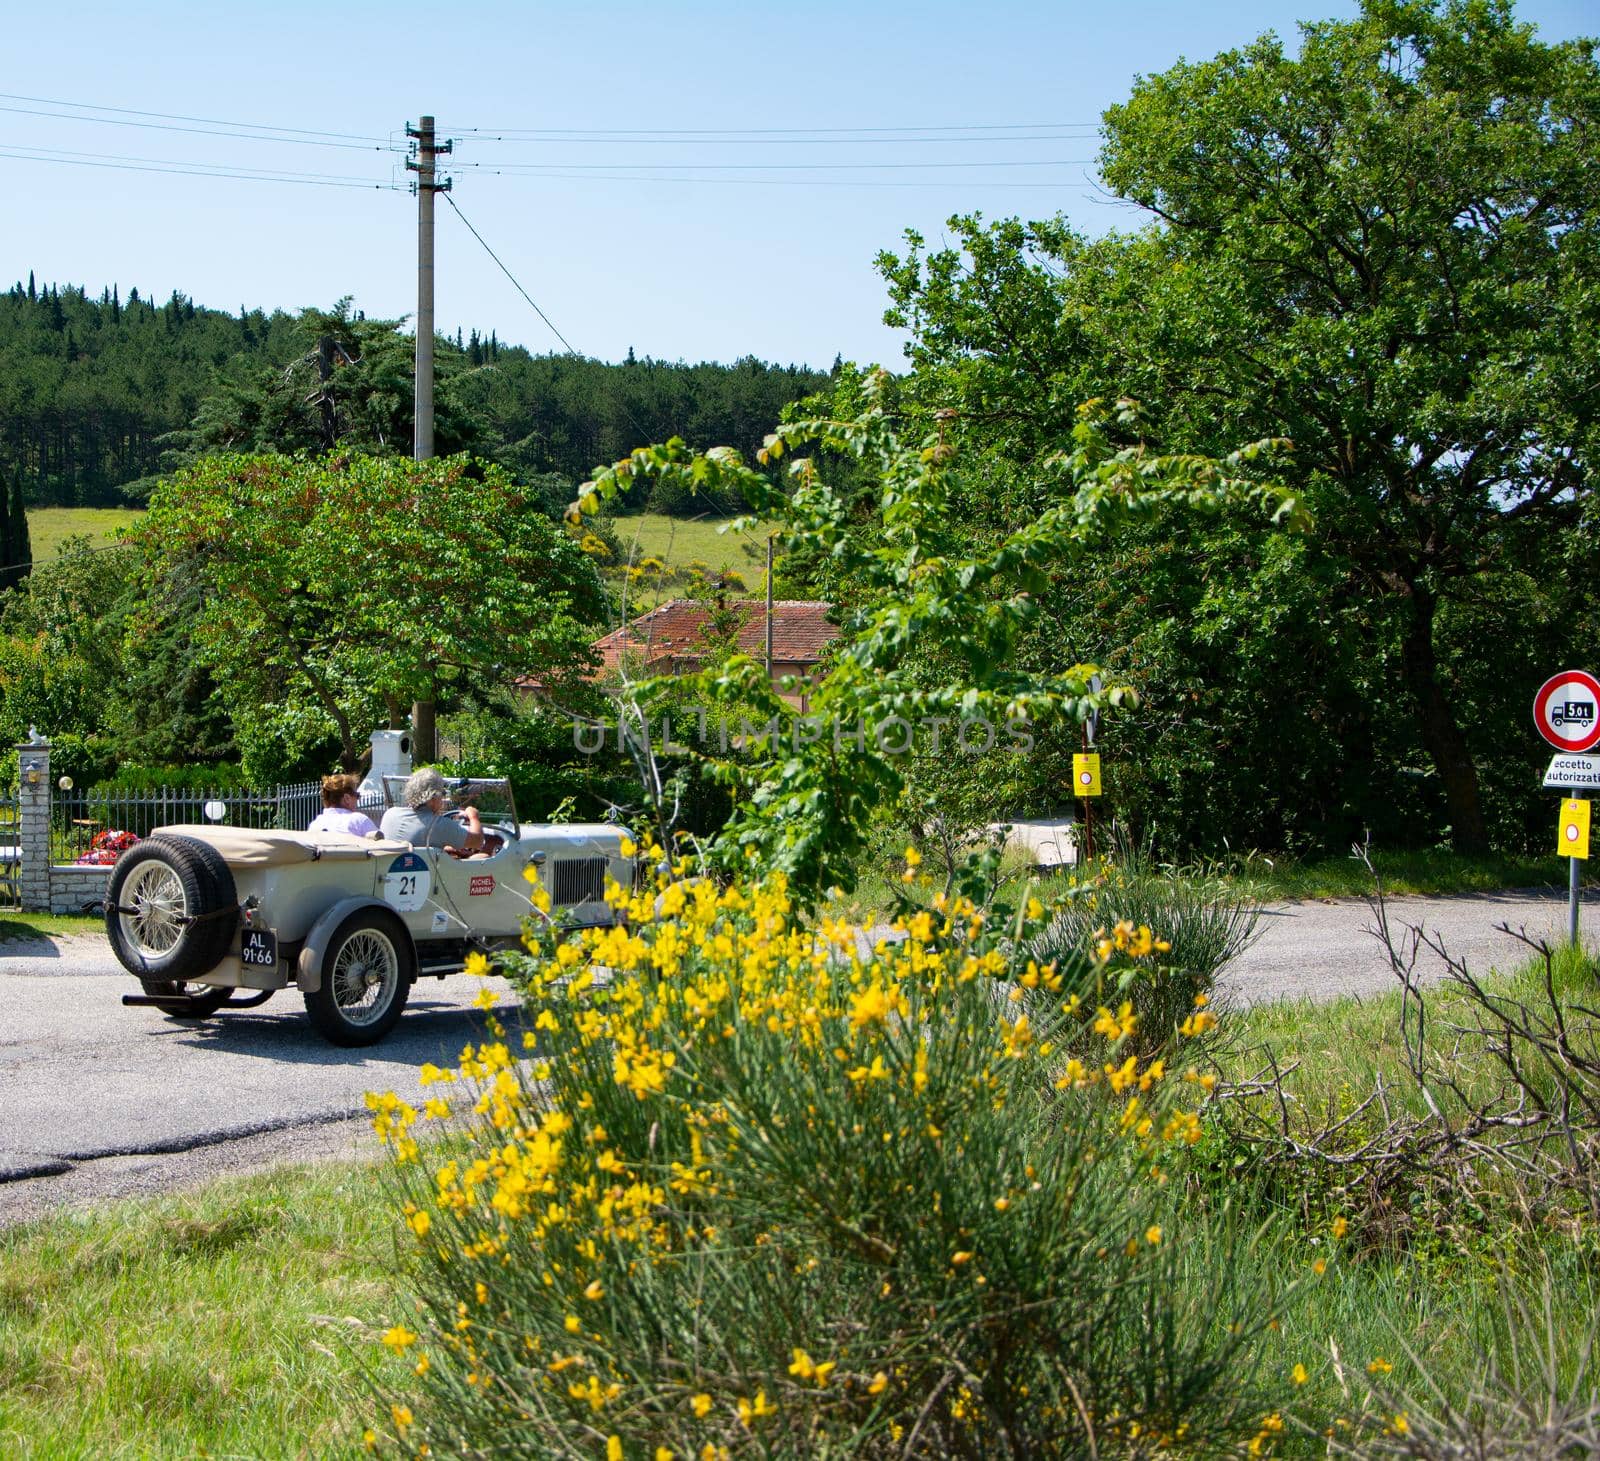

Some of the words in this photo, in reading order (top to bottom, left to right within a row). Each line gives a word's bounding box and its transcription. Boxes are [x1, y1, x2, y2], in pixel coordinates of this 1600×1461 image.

[1554, 760, 1592, 770] eccetto
[1547, 771, 1600, 783] autorizzati
[399, 875, 416, 896] 21
[250, 933, 266, 948] AL
